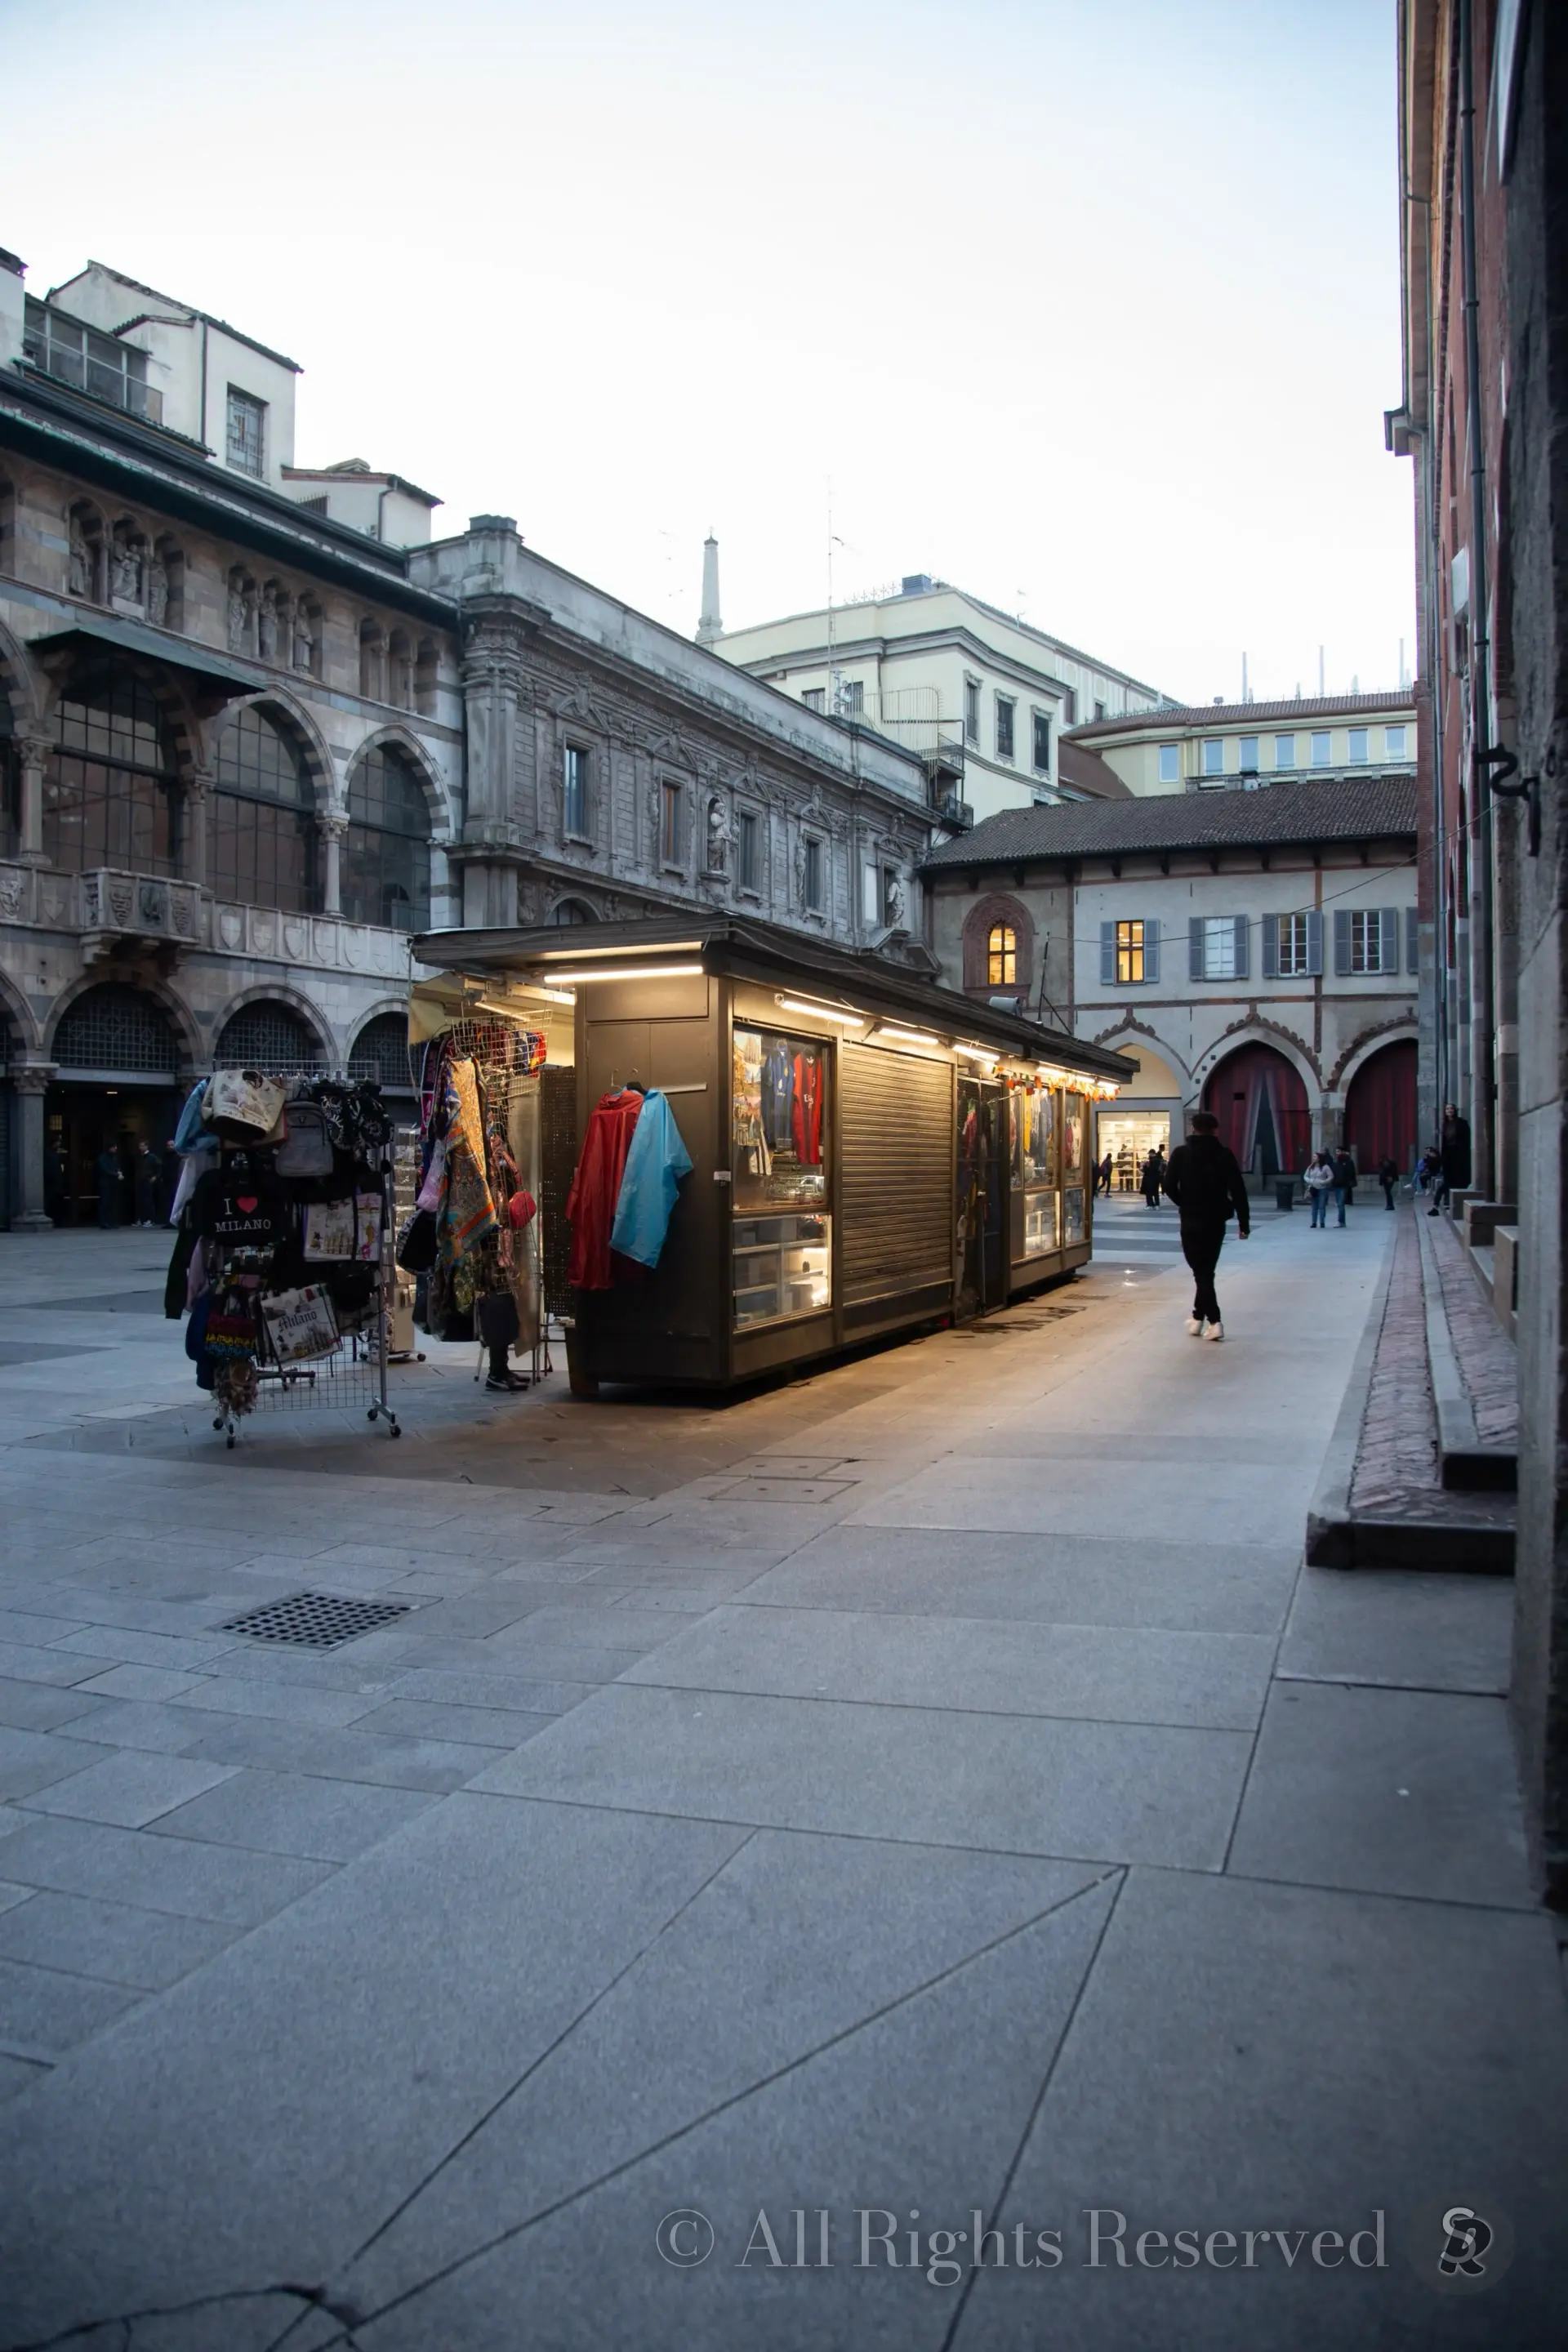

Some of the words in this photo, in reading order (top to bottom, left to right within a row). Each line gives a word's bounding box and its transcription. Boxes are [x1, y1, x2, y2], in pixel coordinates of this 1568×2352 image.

[224, 1198, 233, 1214] I
[216, 1219, 271, 1232] MILANO
[278, 1311, 318, 1332] Milano
